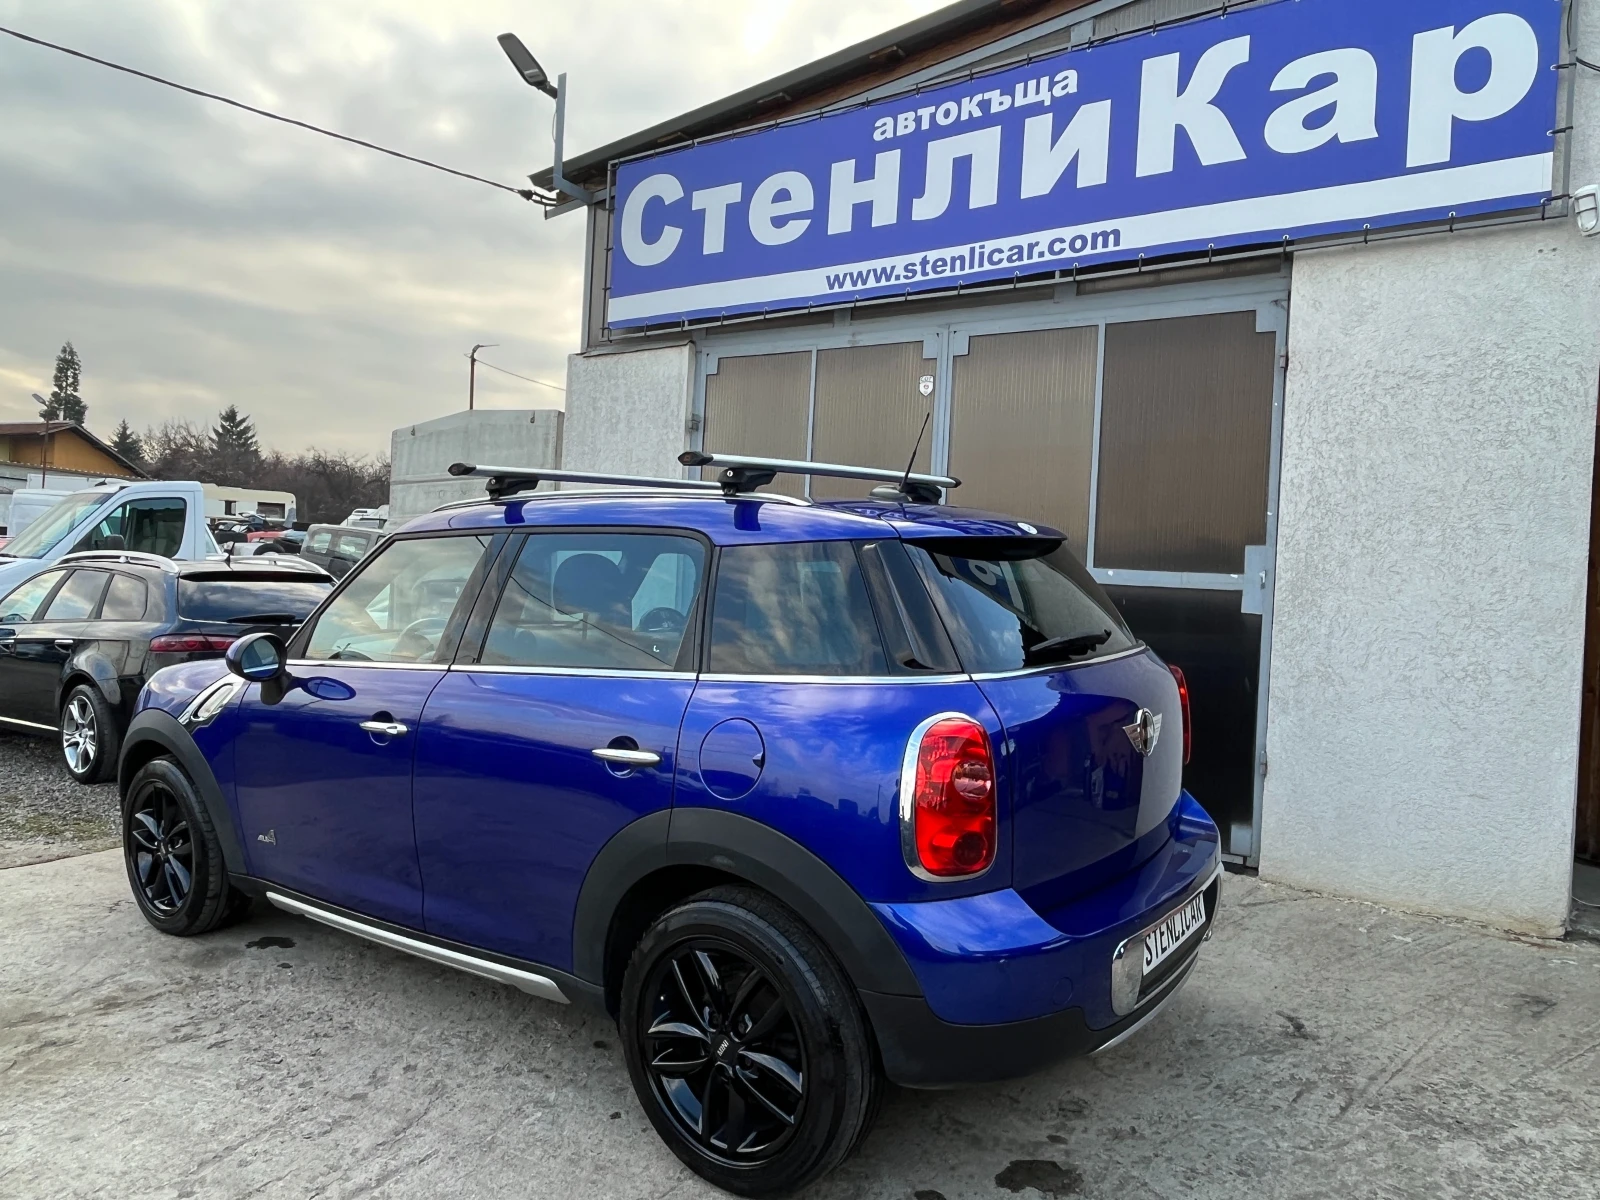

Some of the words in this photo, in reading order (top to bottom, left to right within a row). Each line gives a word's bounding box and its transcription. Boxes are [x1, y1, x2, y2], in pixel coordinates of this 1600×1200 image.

[620, 12, 1540, 268] СтенлиКар
[872, 69, 1079, 142] автокъща
[825, 227, 1122, 291] www.stenlicar.com
[1144, 895, 1203, 967] STENLICAR
